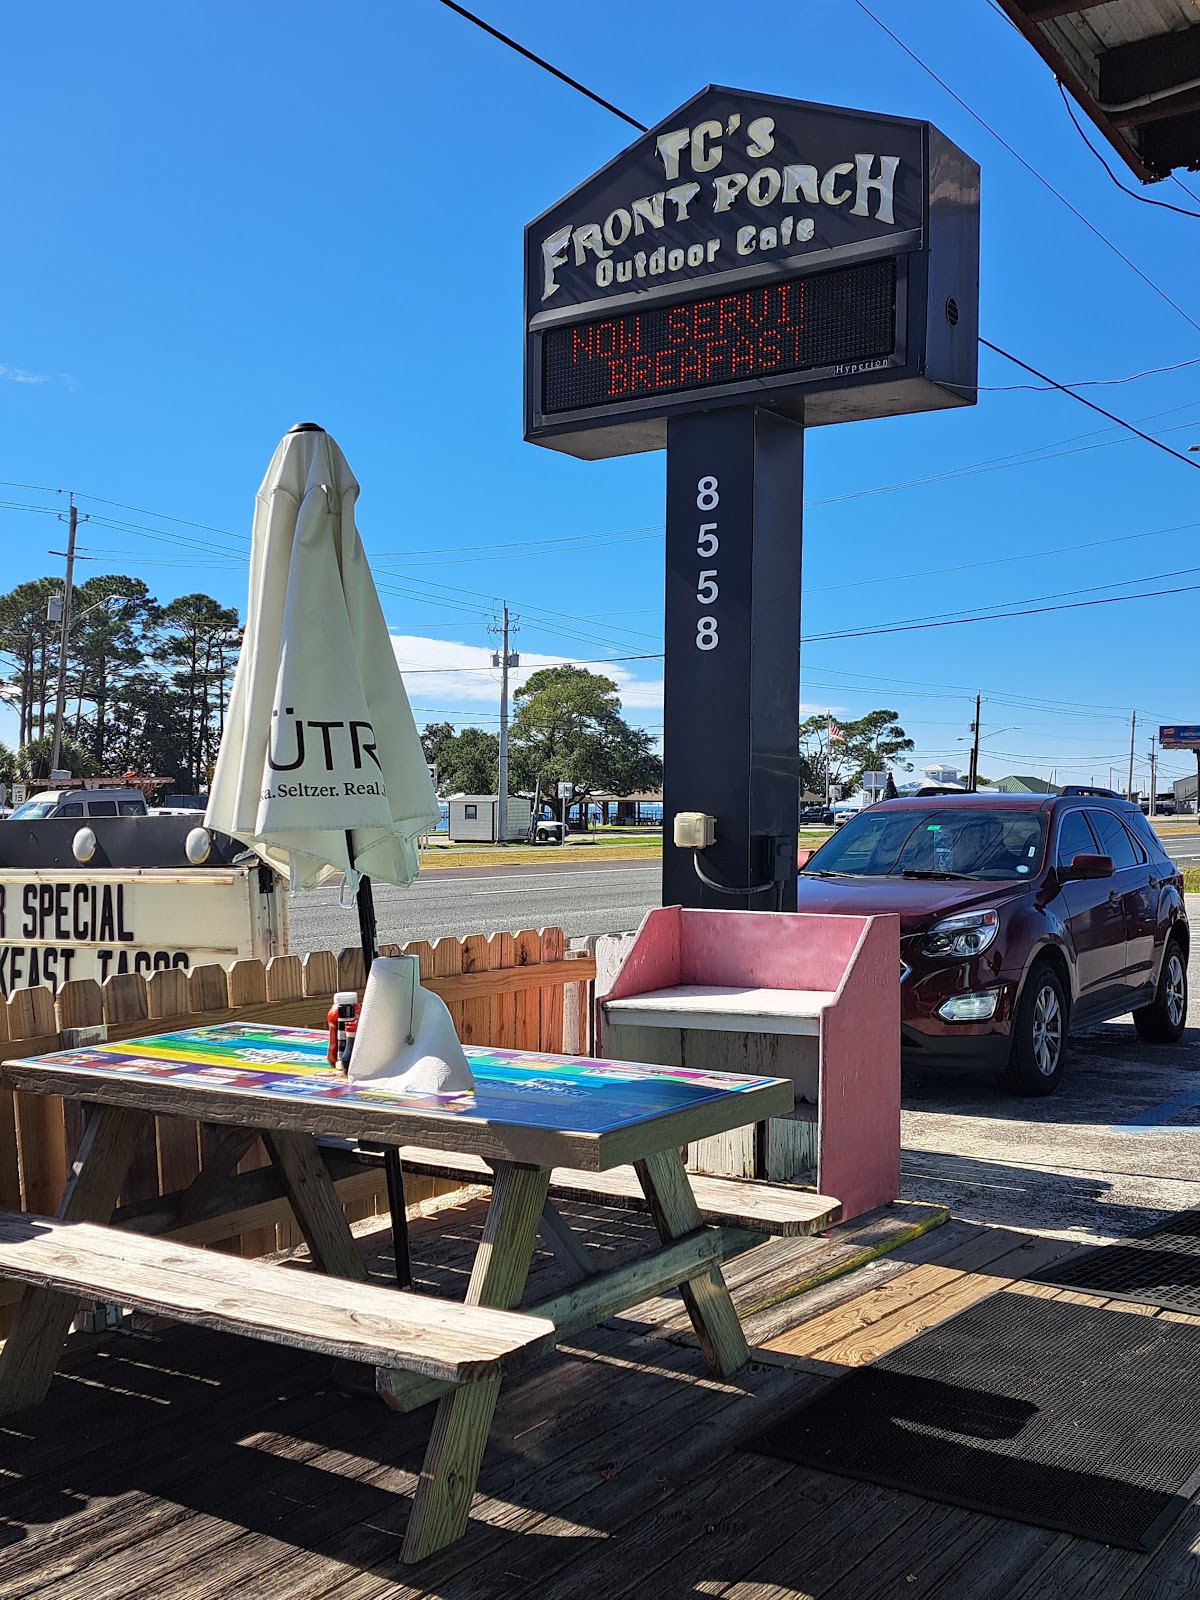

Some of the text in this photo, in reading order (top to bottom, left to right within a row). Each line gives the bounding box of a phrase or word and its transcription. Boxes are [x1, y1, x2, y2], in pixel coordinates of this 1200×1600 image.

[655, 113, 776, 181] TC'S
[541, 153, 901, 301] FRONT PORCH
[595, 215, 816, 287] Outdoor Cafe
[571, 317, 641, 364] NOW
[607, 325, 806, 396] BREAFAST
[836, 359, 888, 375] Hyperion
[14, 794, 24, 802] 15
[277, 782, 340, 798] Seltzer.
[343, 781, 381, 796] Real
[23, 883, 134, 942] SPECIAL
